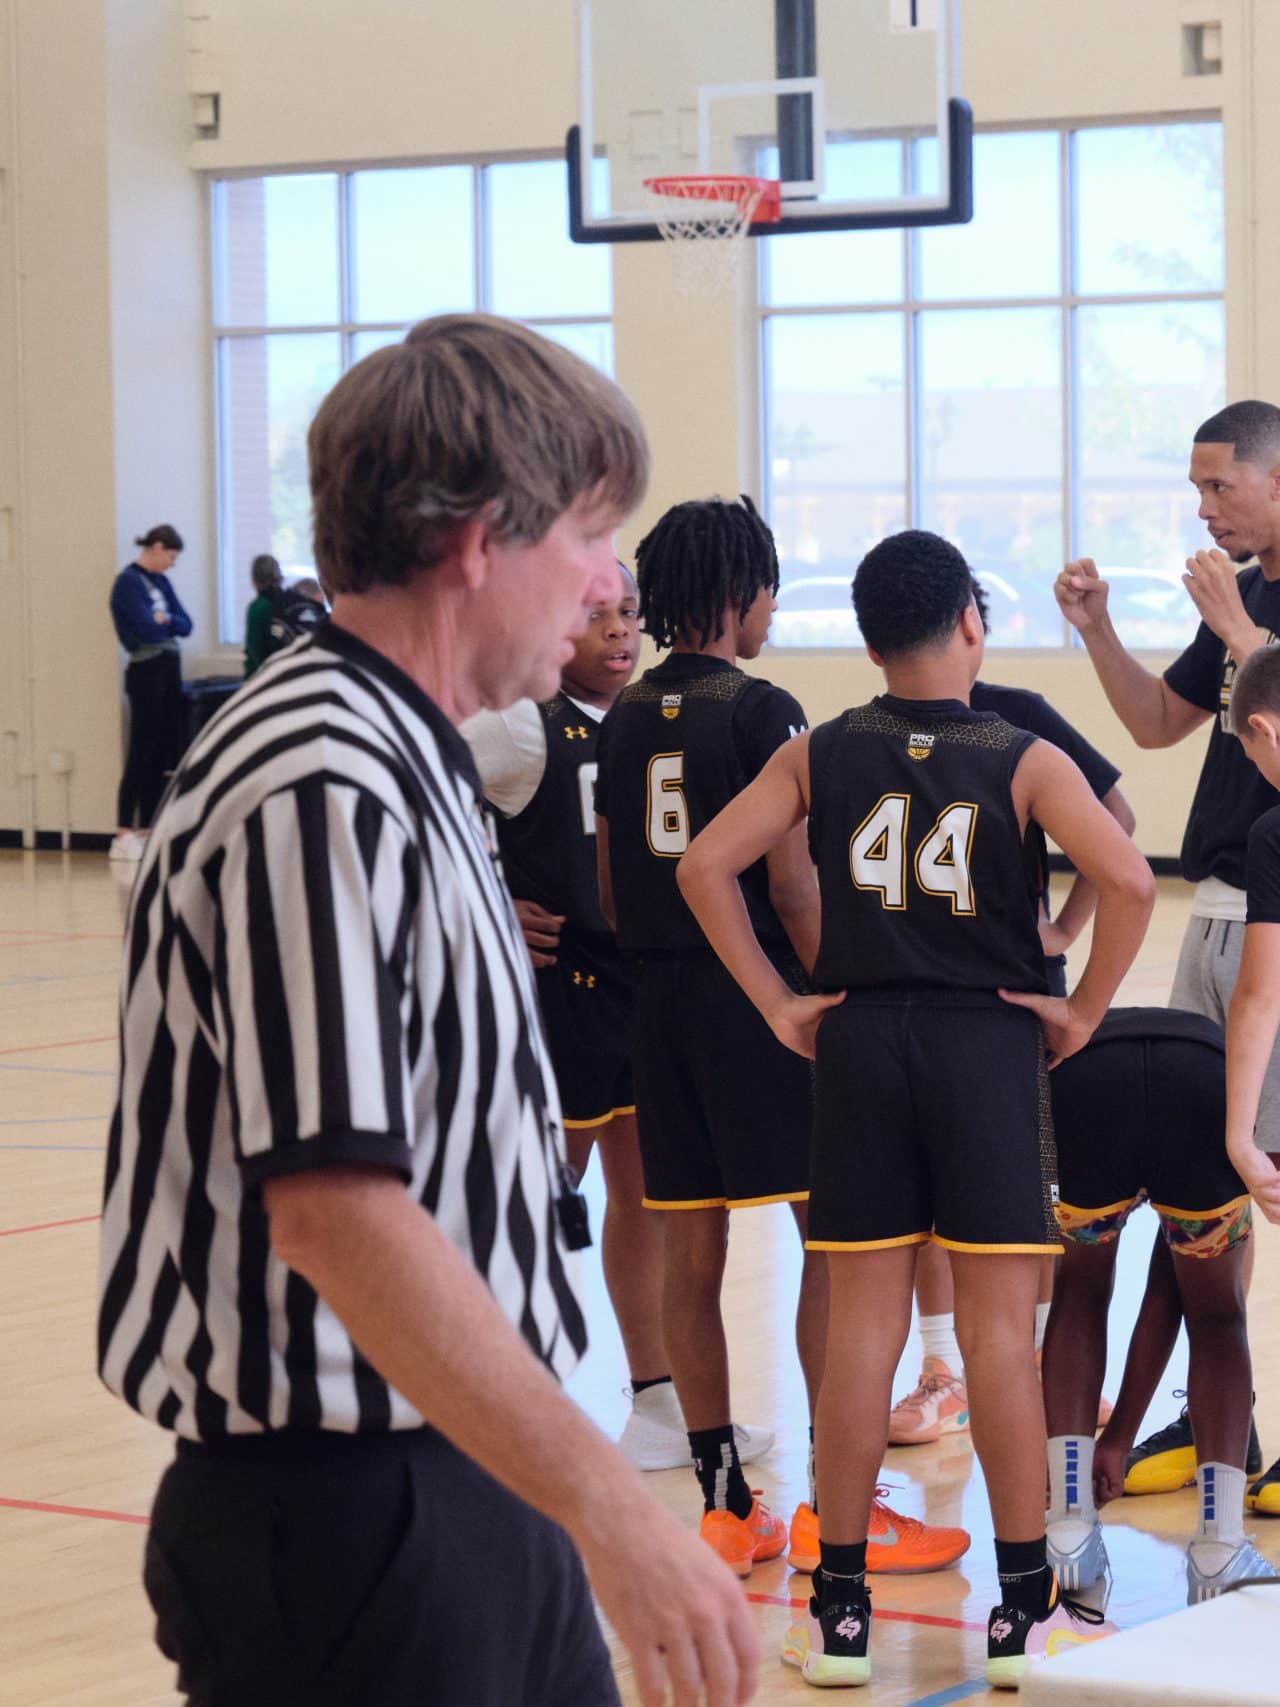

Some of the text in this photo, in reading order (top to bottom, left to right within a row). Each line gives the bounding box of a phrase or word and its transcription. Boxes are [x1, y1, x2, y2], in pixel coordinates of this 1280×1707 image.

[910, 733, 935, 742] PRO
[645, 751, 690, 858] 6
[849, 792, 979, 917] 44
